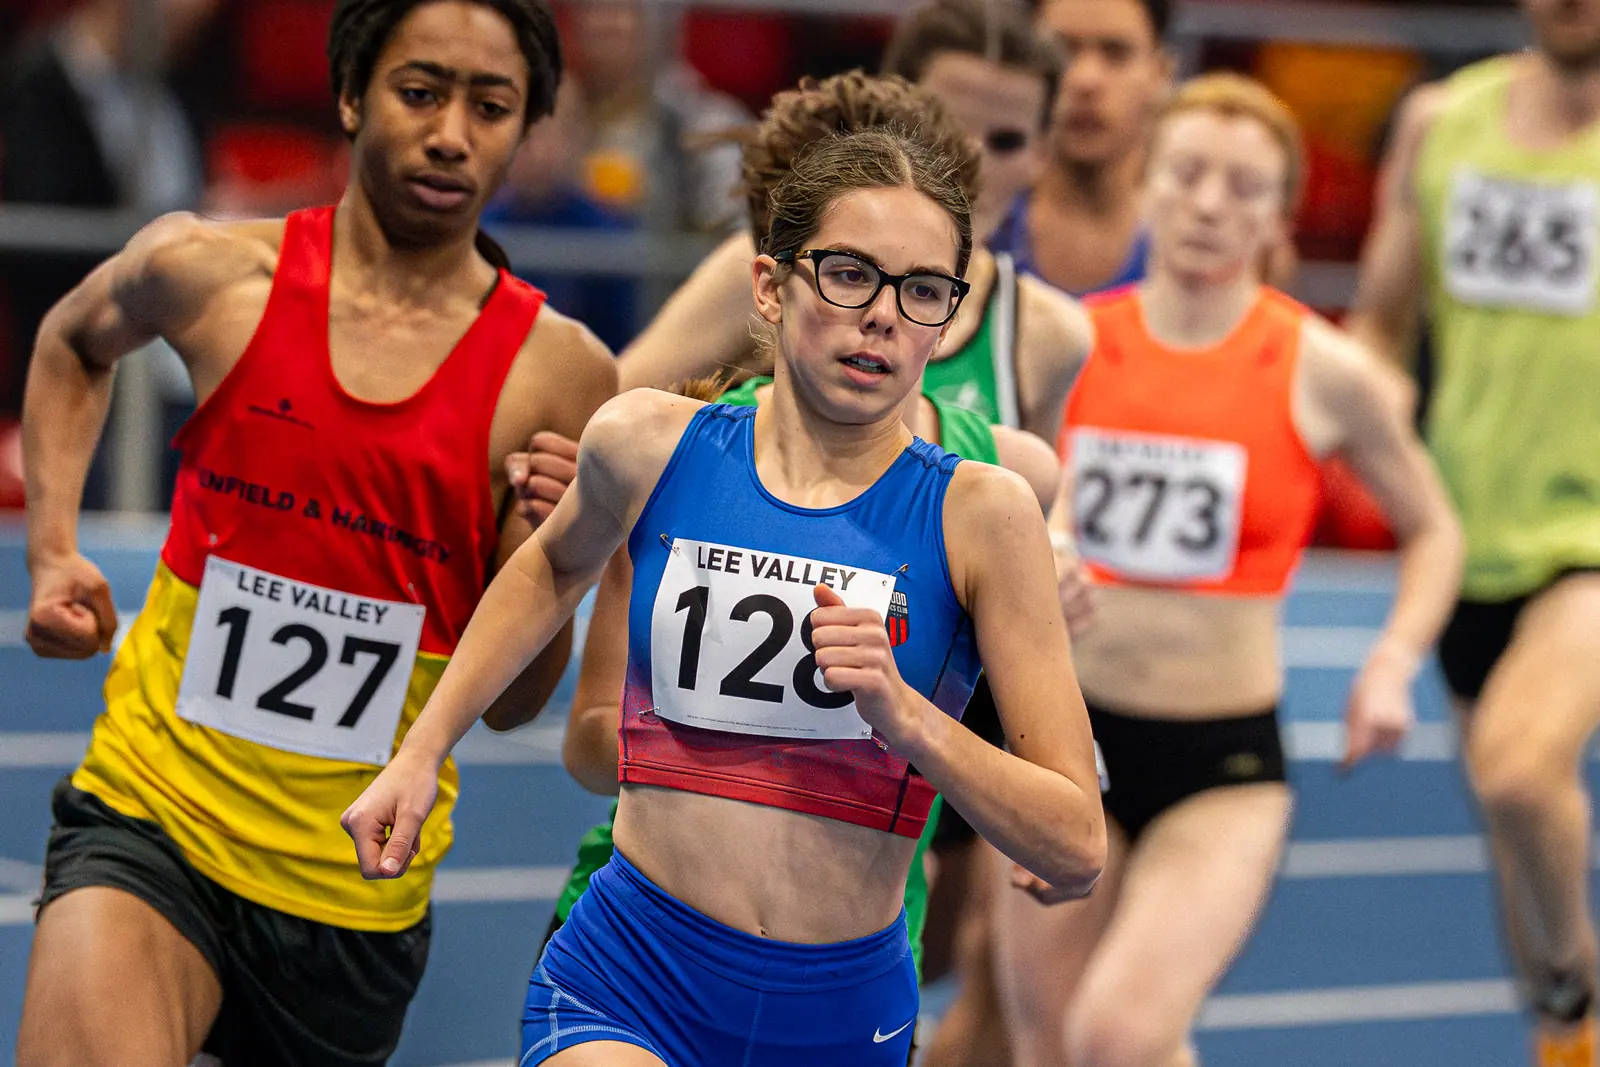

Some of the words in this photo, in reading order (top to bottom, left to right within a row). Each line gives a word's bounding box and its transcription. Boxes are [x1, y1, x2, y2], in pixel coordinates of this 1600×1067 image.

[303, 498, 321, 519] &
[1081, 468, 1222, 553] 273
[698, 546, 743, 574] LEE
[751, 554, 856, 591] VALLEY
[237, 572, 282, 601] LEE
[291, 587, 389, 625] VALLEY
[215, 606, 401, 728] 127
